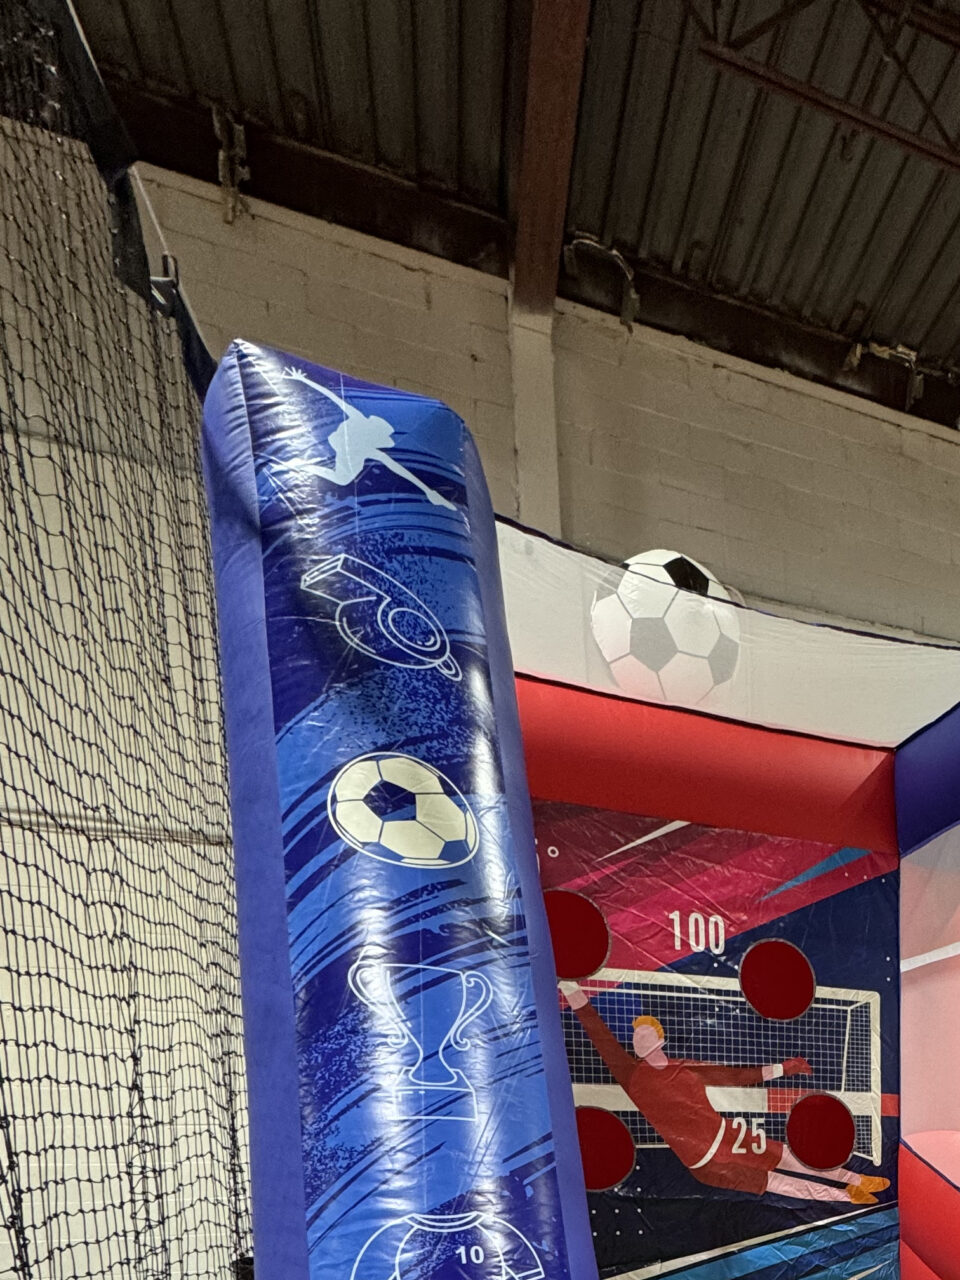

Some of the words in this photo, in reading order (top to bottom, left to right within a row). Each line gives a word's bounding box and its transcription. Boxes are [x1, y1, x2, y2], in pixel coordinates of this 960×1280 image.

[669, 910, 725, 955] 100
[731, 1117, 767, 1155] 25
[455, 1245, 485, 1265] 10
